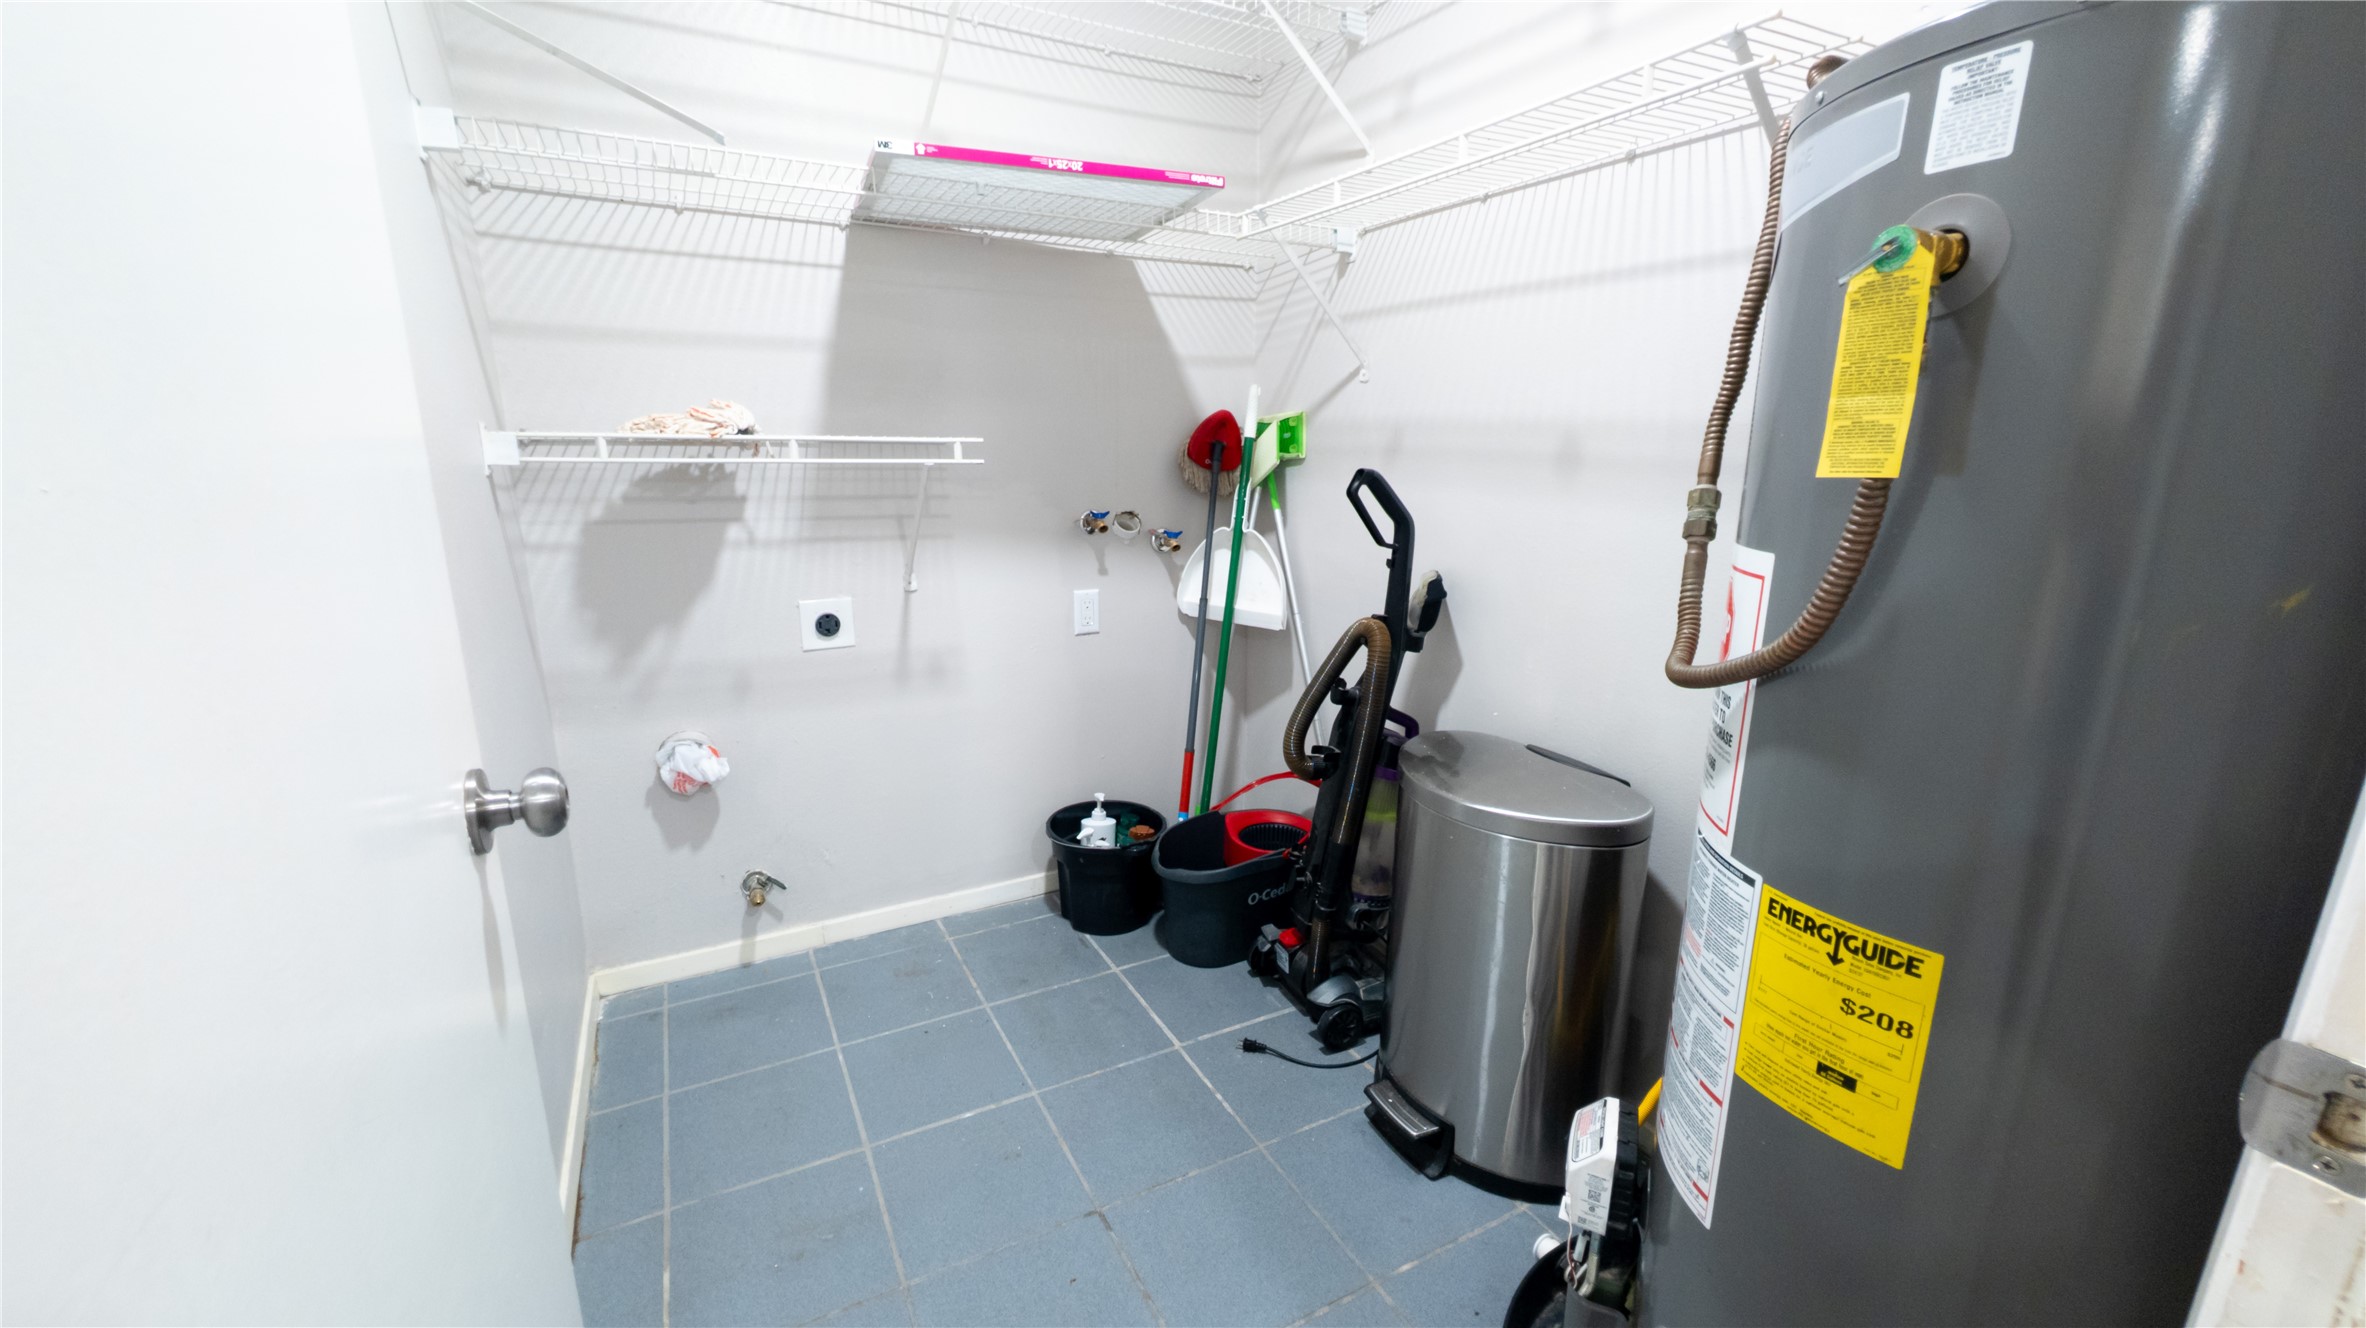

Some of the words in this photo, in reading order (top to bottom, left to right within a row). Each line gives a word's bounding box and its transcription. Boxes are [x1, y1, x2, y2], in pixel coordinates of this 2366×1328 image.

[1247, 882, 1291, 905] O-Ced
[1768, 897, 1925, 979] ENERGYGUIDE
[1783, 953, 1810, 971] Estimated
[1812, 967, 1830, 981] Yearly
[1832, 977, 1854, 993] Energy
[1856, 987, 1871, 999] Cost
[1840, 998, 1914, 1039] $208
[1793, 1033, 1807, 1044] First
[1808, 1042, 1822, 1053] Hour
[1824, 1049, 1845, 1065] Rating
